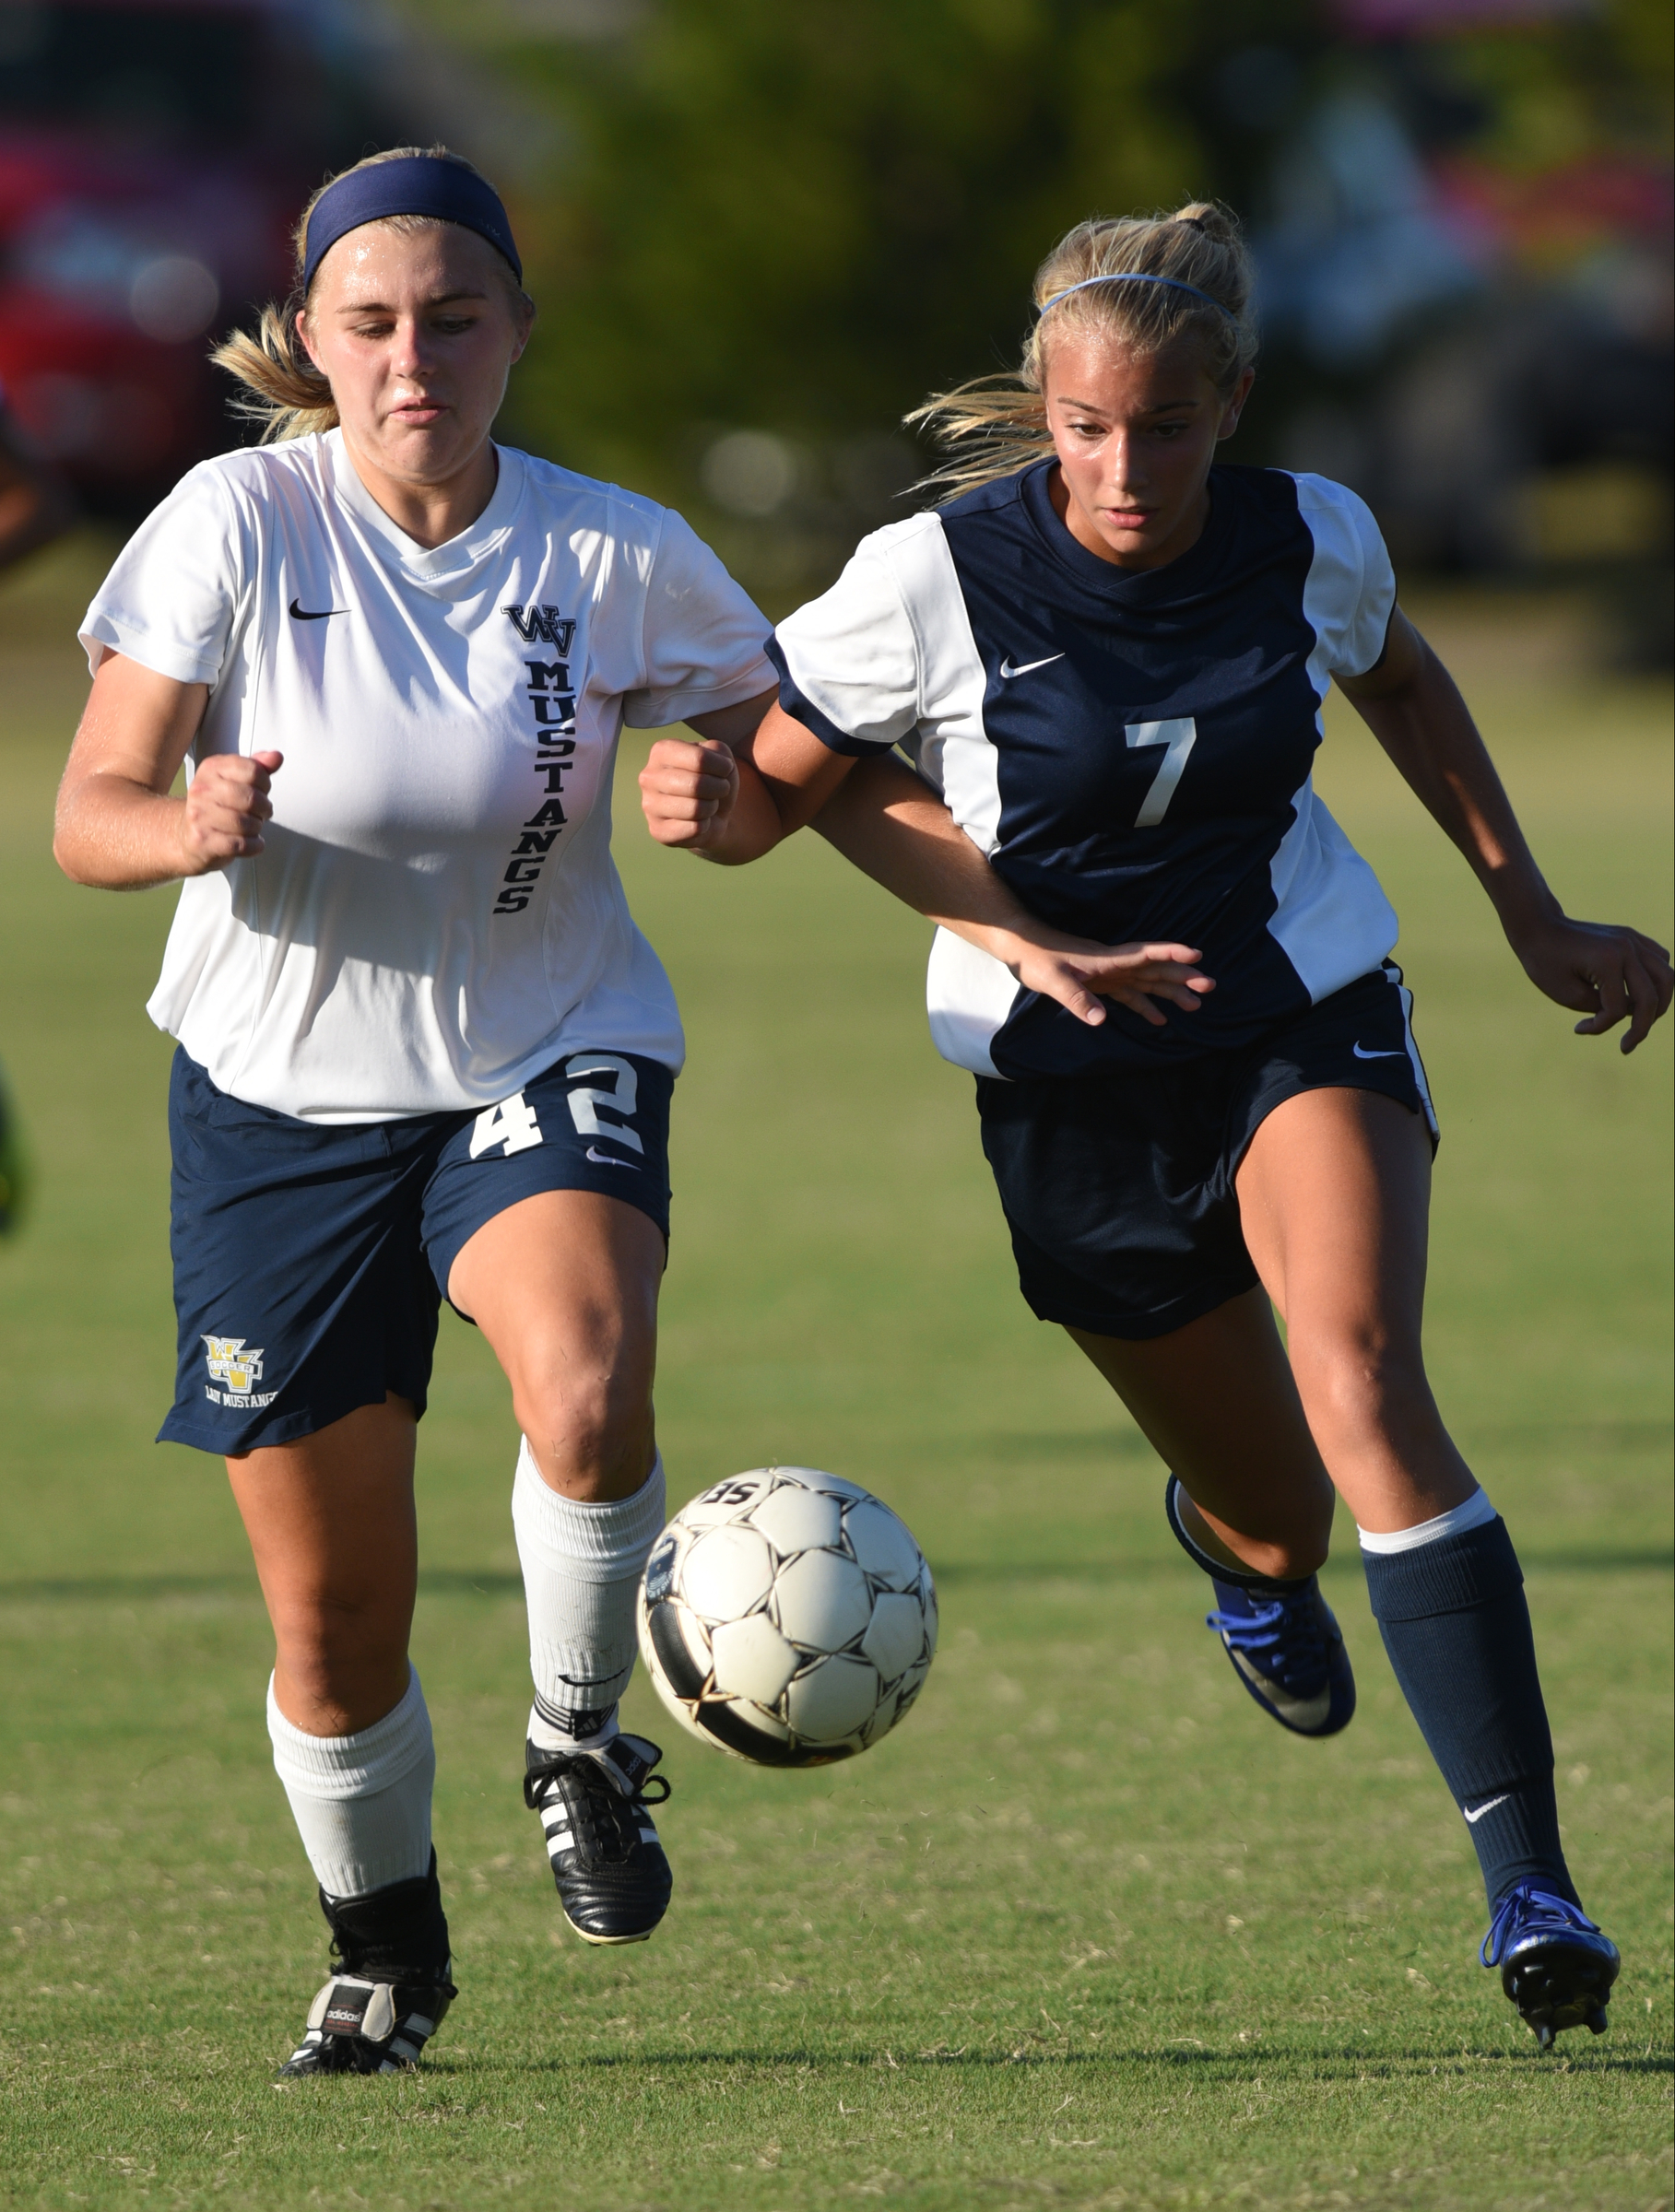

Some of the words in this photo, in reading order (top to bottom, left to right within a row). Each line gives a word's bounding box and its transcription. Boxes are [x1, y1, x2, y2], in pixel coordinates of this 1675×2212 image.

[501, 604, 576, 658] WV
[492, 660, 577, 915] MUSTANGS
[1124, 716, 1197, 828] 7
[469, 1053, 644, 1159] 42
[210, 1360, 251, 1373] SOCCER
[326, 2009, 360, 2023] adidas
